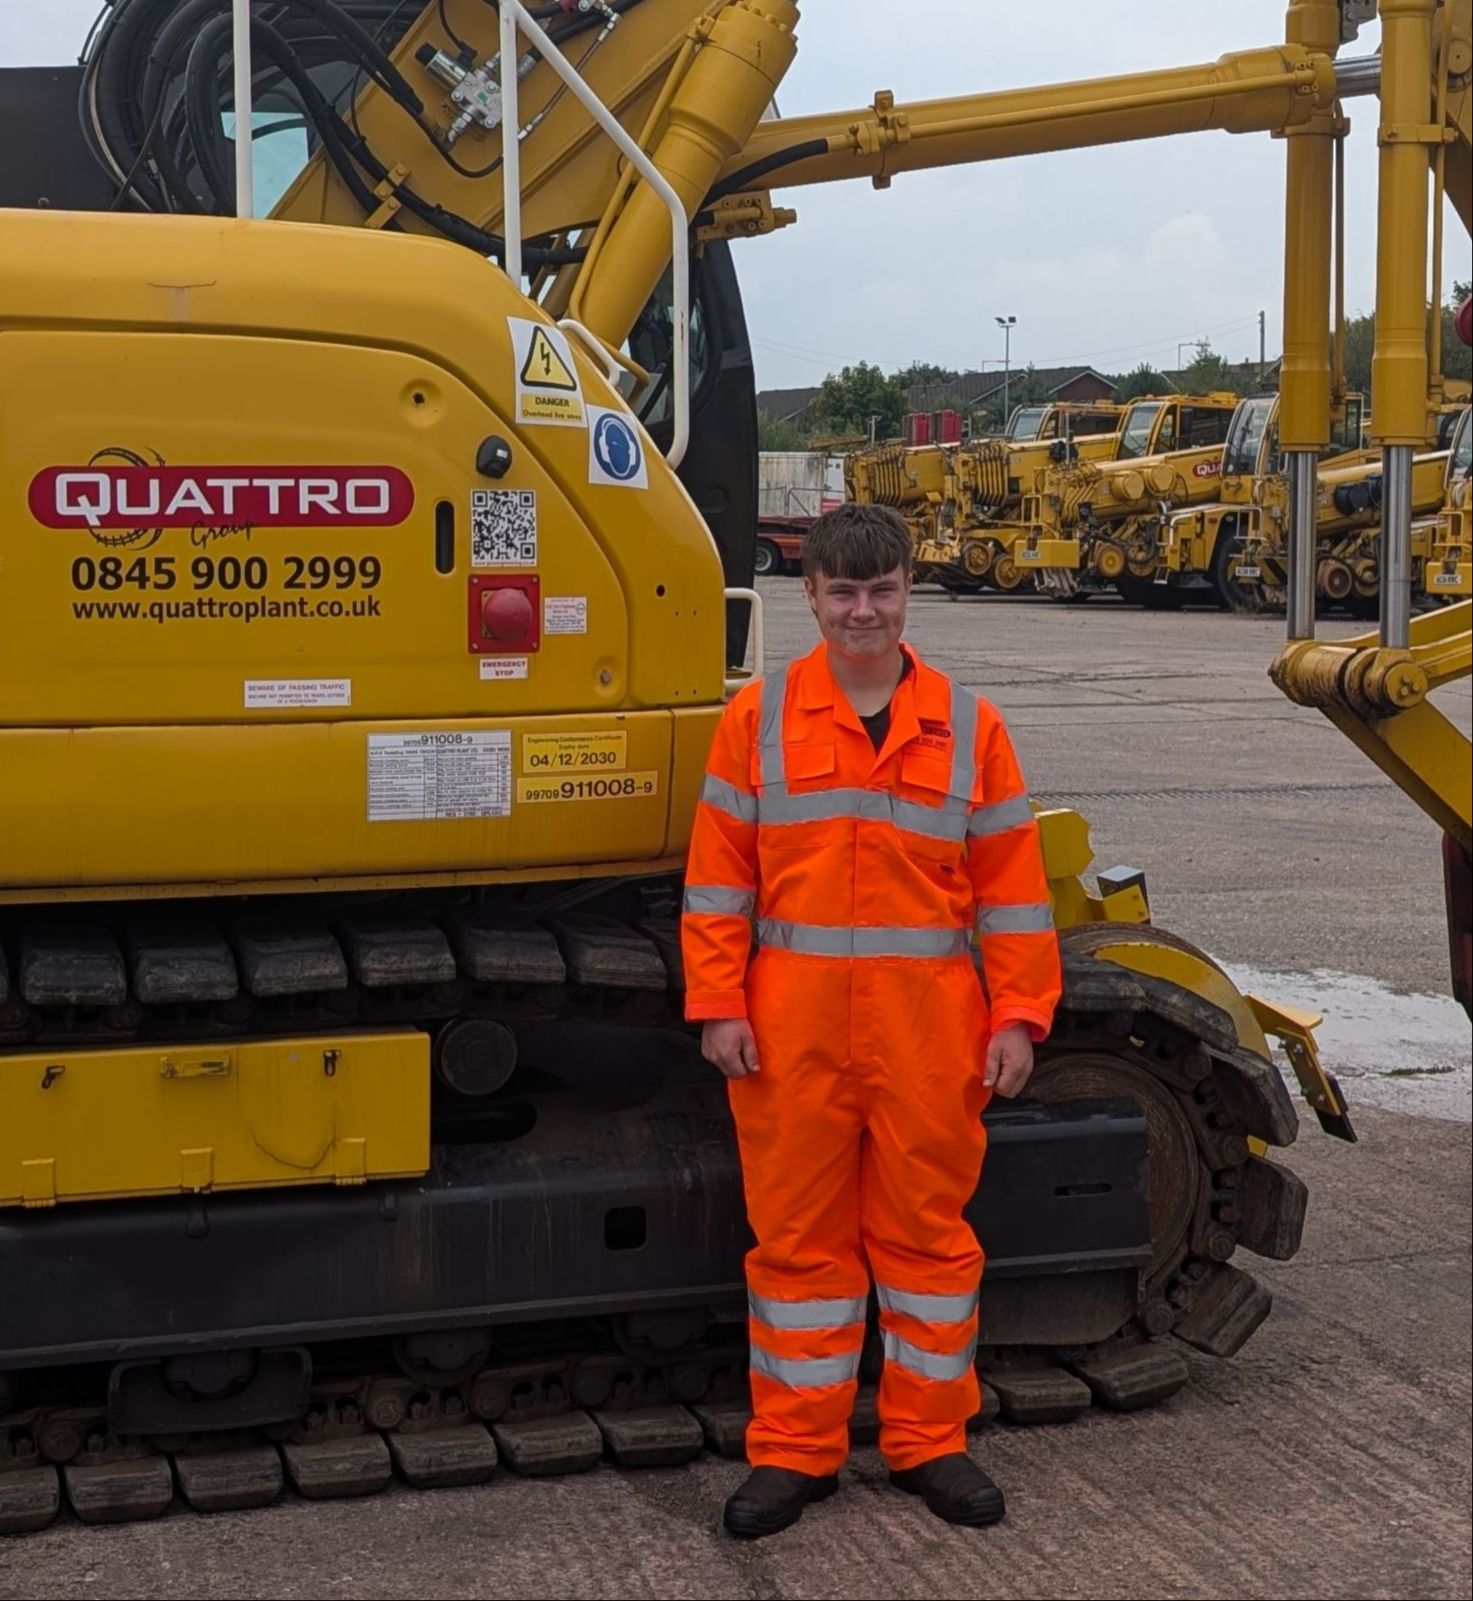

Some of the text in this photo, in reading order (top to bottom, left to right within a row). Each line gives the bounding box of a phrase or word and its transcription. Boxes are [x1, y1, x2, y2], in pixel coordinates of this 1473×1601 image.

[534, 396, 570, 408] DANGER
[522, 409, 554, 419] Overhead
[55, 473, 390, 526] QUATTRO
[191, 520, 255, 550] Group
[71, 555, 382, 590] 0845 900 2999
[73, 595, 381, 623] www.quattroplant.co.uk
[482, 661, 526, 669] EMERGENCY
[495, 669, 514, 677] STOP
[248, 684, 275, 692] BEWARE
[320, 683, 345, 691] TRAFFIC
[530, 751, 616, 768] 04/12/2030
